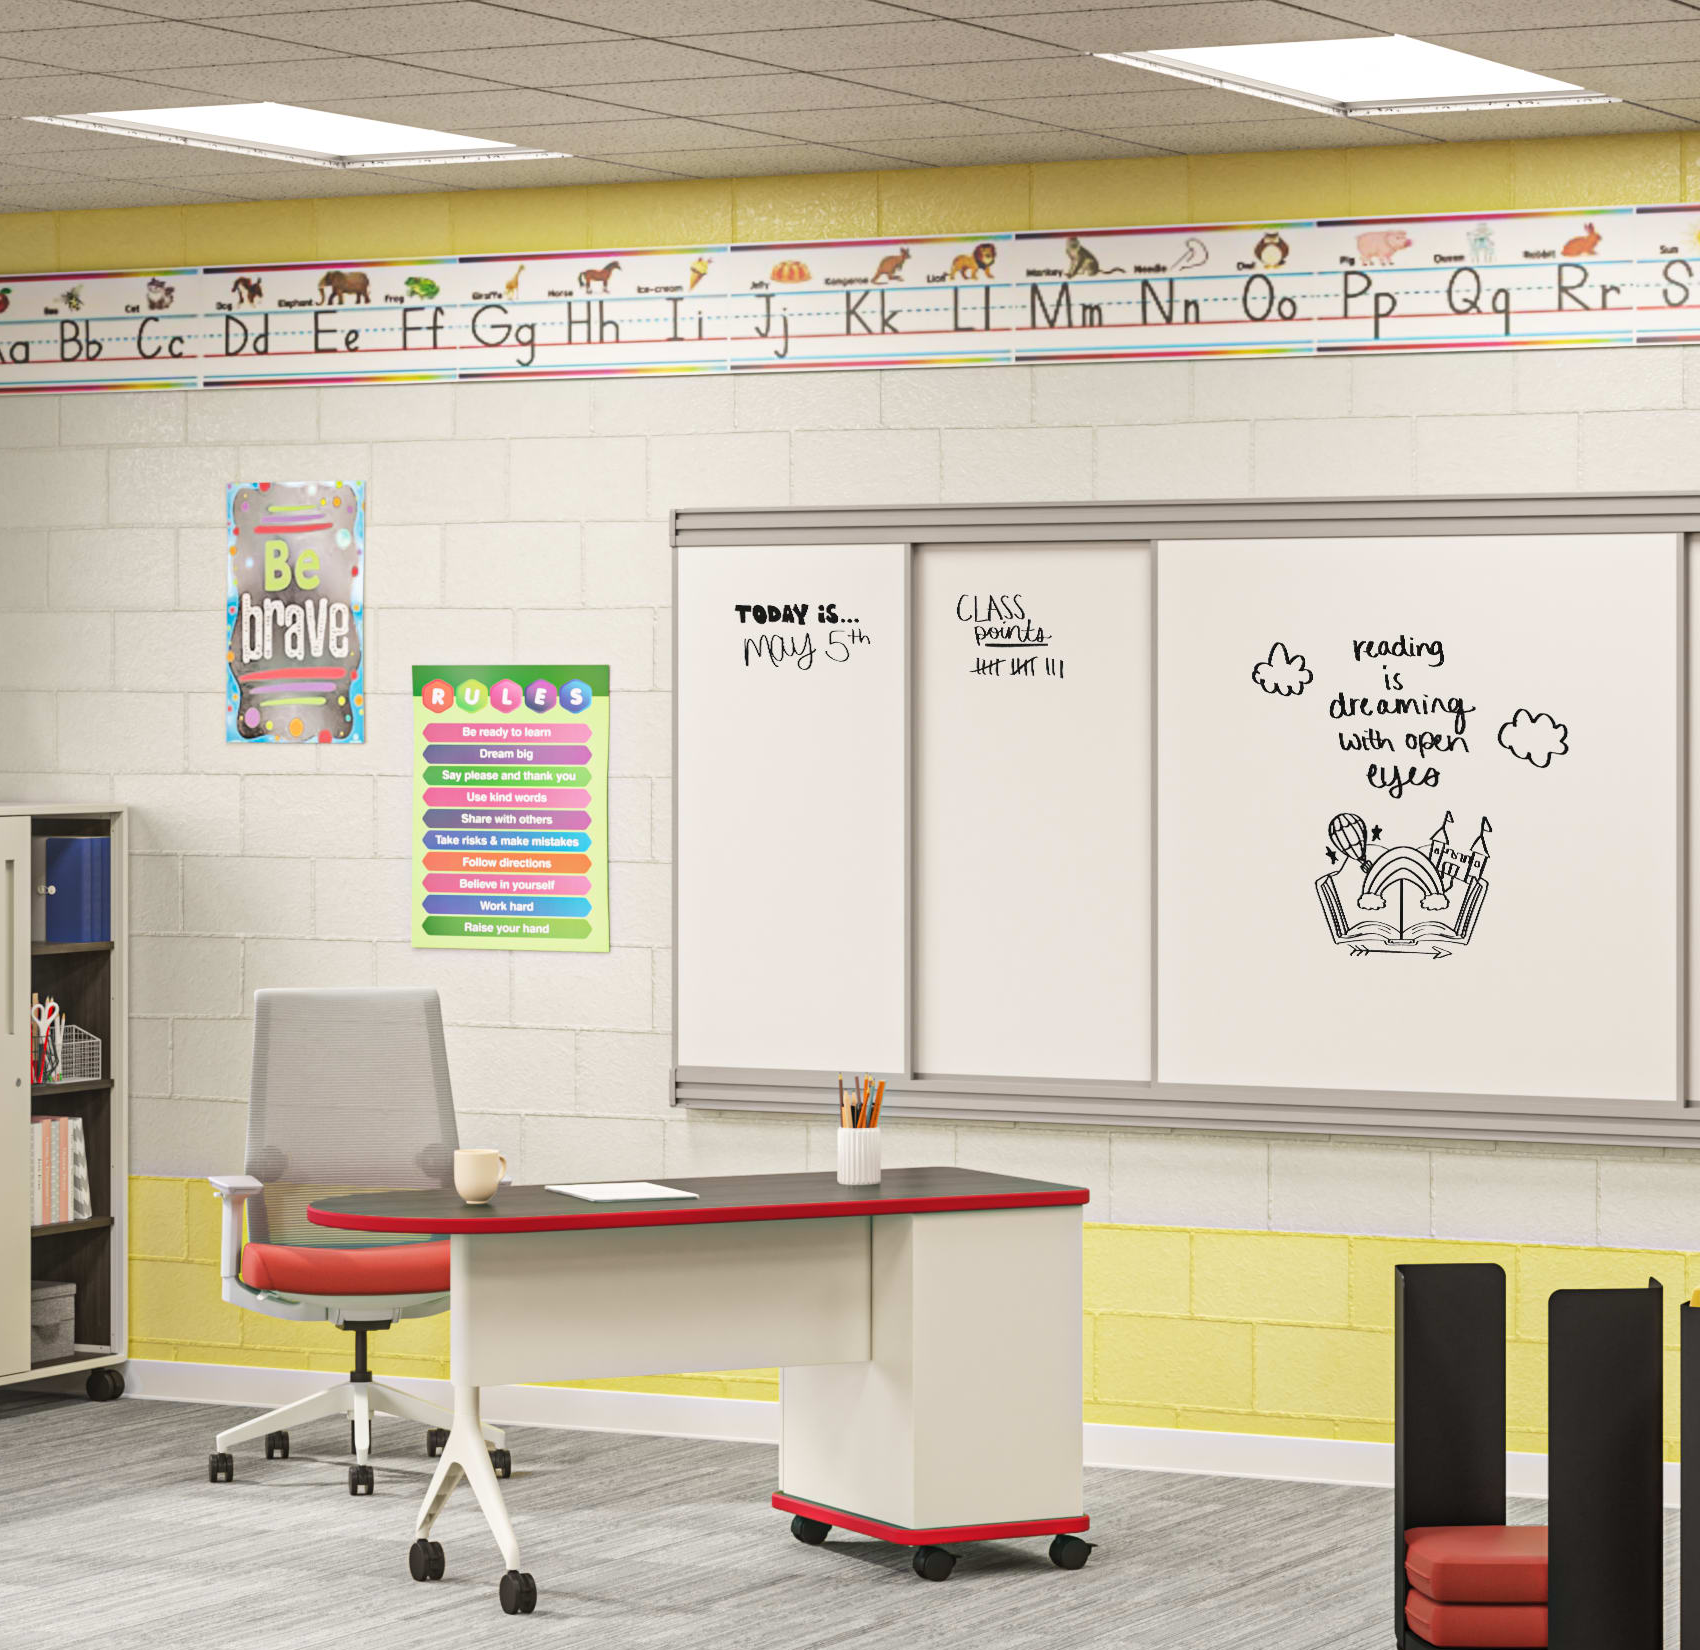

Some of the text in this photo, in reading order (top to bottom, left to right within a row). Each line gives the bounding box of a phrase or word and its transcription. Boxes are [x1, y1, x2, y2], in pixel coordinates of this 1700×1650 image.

[1340, 256, 1355, 266] Pig
[278, 299, 313, 309] Elephant
[385, 295, 404, 304] Frog
[265, 540, 321, 592] Be
[735, 604, 808, 625] TODAY
[957, 594, 1025, 623] CLASS
[241, 593, 349, 663] brave
[974, 619, 1052, 646] points
[825, 629, 870, 662] 5th
[1353, 635, 1444, 668] reading
[1383, 665, 1403, 690] is
[431, 687, 583, 706] RULES
[1330, 692, 1476, 736] dreaming
[462, 727, 551, 738] Be ready to learn
[1339, 728, 1469, 758] with open
[480, 749, 533, 760] Dream big
[442, 770, 576, 782] Say please and thank you
[1366, 764, 1440, 799] eyes
[467, 792, 547, 802] Use kind words
[461, 814, 552, 824] Share with others
[435, 835, 579, 846] Take risks & make mistakes
[462, 857, 551, 868] Follow directions
[460, 879, 555, 891] Believe in yourself
[480, 901, 533, 911] Work hard
[464, 922, 549, 934] Raise your hand
